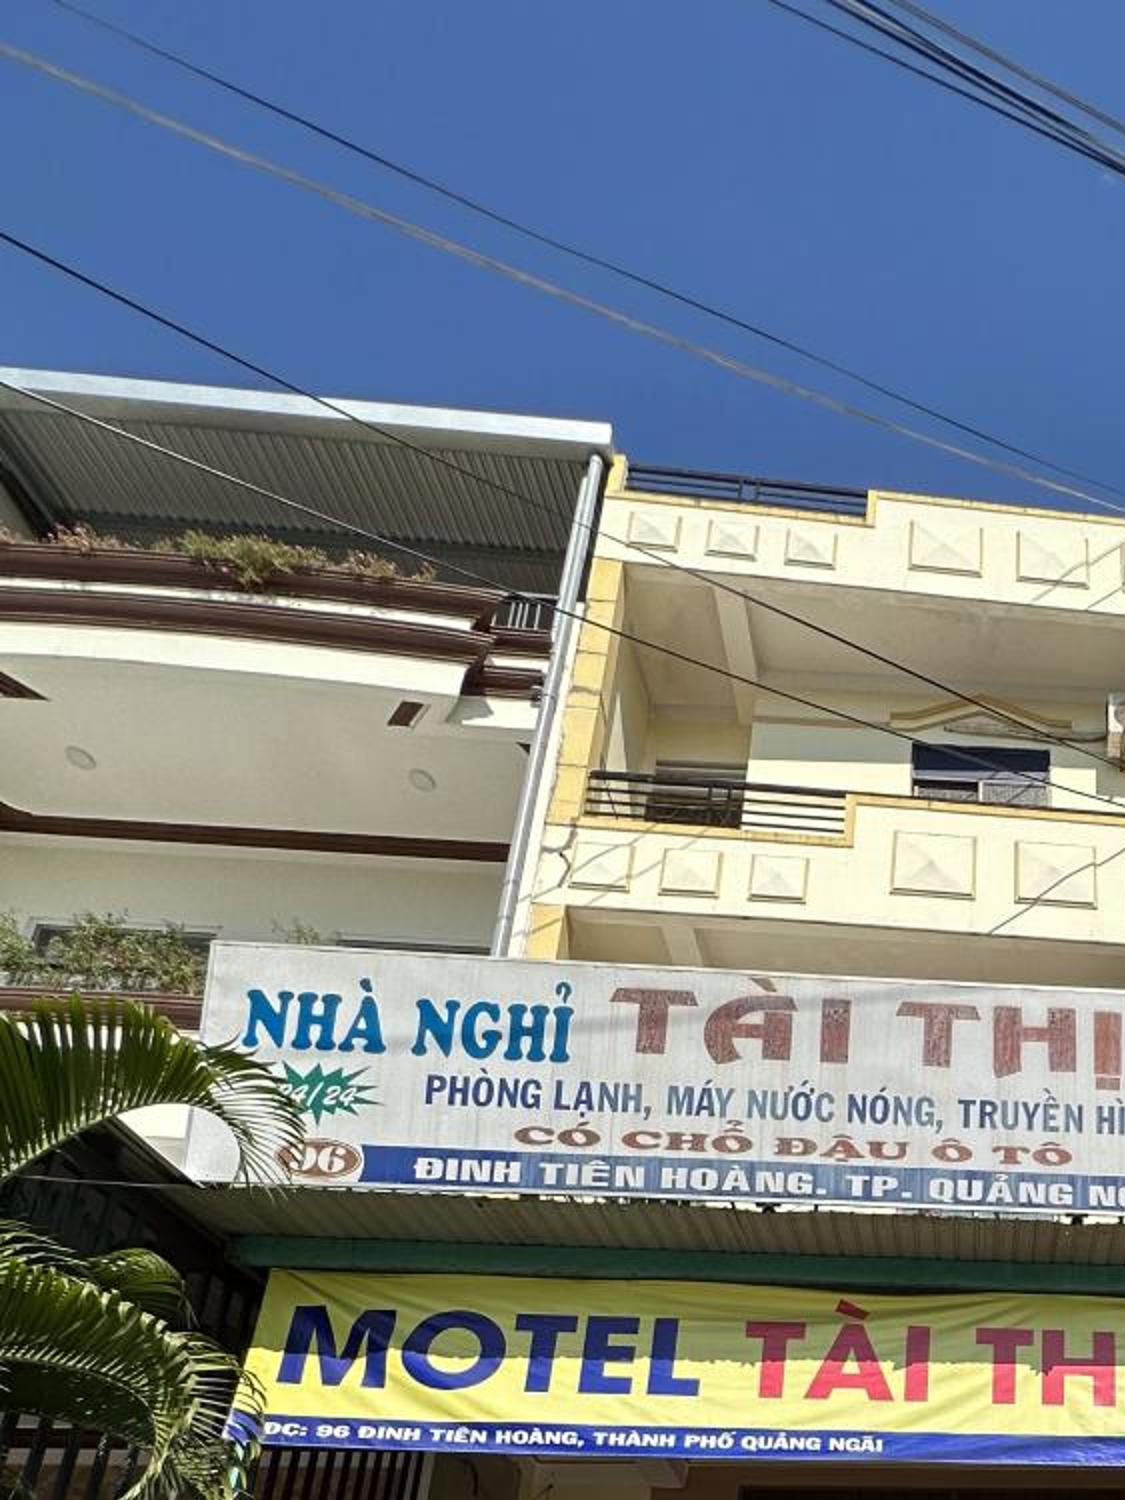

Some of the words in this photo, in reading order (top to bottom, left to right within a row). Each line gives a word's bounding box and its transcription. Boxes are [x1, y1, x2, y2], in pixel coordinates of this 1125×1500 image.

[243, 978, 384, 1053] NHÀ
[411, 981, 575, 1064] NGHỈ
[609, 977, 853, 1066] TÀI
[425, 1068, 542, 1110] PHÒNG
[553, 1081, 651, 1122] LẠNH,
[667, 1080, 733, 1119] MÁY
[747, 1080, 834, 1124] NƯỚC
[846, 1087, 944, 1134] NÓNG,
[958, 1088, 1084, 1136] TRUYỀN
[514, 1121, 600, 1148] CÓ
[775, 1134, 908, 1165] ĐẬU
[931, 1138, 973, 1163] Ô
[992, 1141, 1073, 1167] TÔ
[414, 1156, 522, 1184] ĐINH
[539, 1157, 644, 1189] TIÊN
[845, 1174, 912, 1199] TP.
[929, 1172, 1073, 1207] QUẢNG
[276, 1305, 700, 1397] MOTEL
[746, 1299, 931, 1402] TÀI
[264, 1423, 307, 1438] ĐC:
[316, 1425, 350, 1440] 96
[358, 1425, 421, 1442] ĐINH
[430, 1425, 486, 1444] TIÊN
[496, 1425, 585, 1448] HOÀNG,
[594, 1428, 675, 1449] THÀNH
[684, 1429, 734, 1450] PHỐ
[741, 1429, 821, 1453] QUẢNG
[828, 1432, 883, 1454] NGÃI
